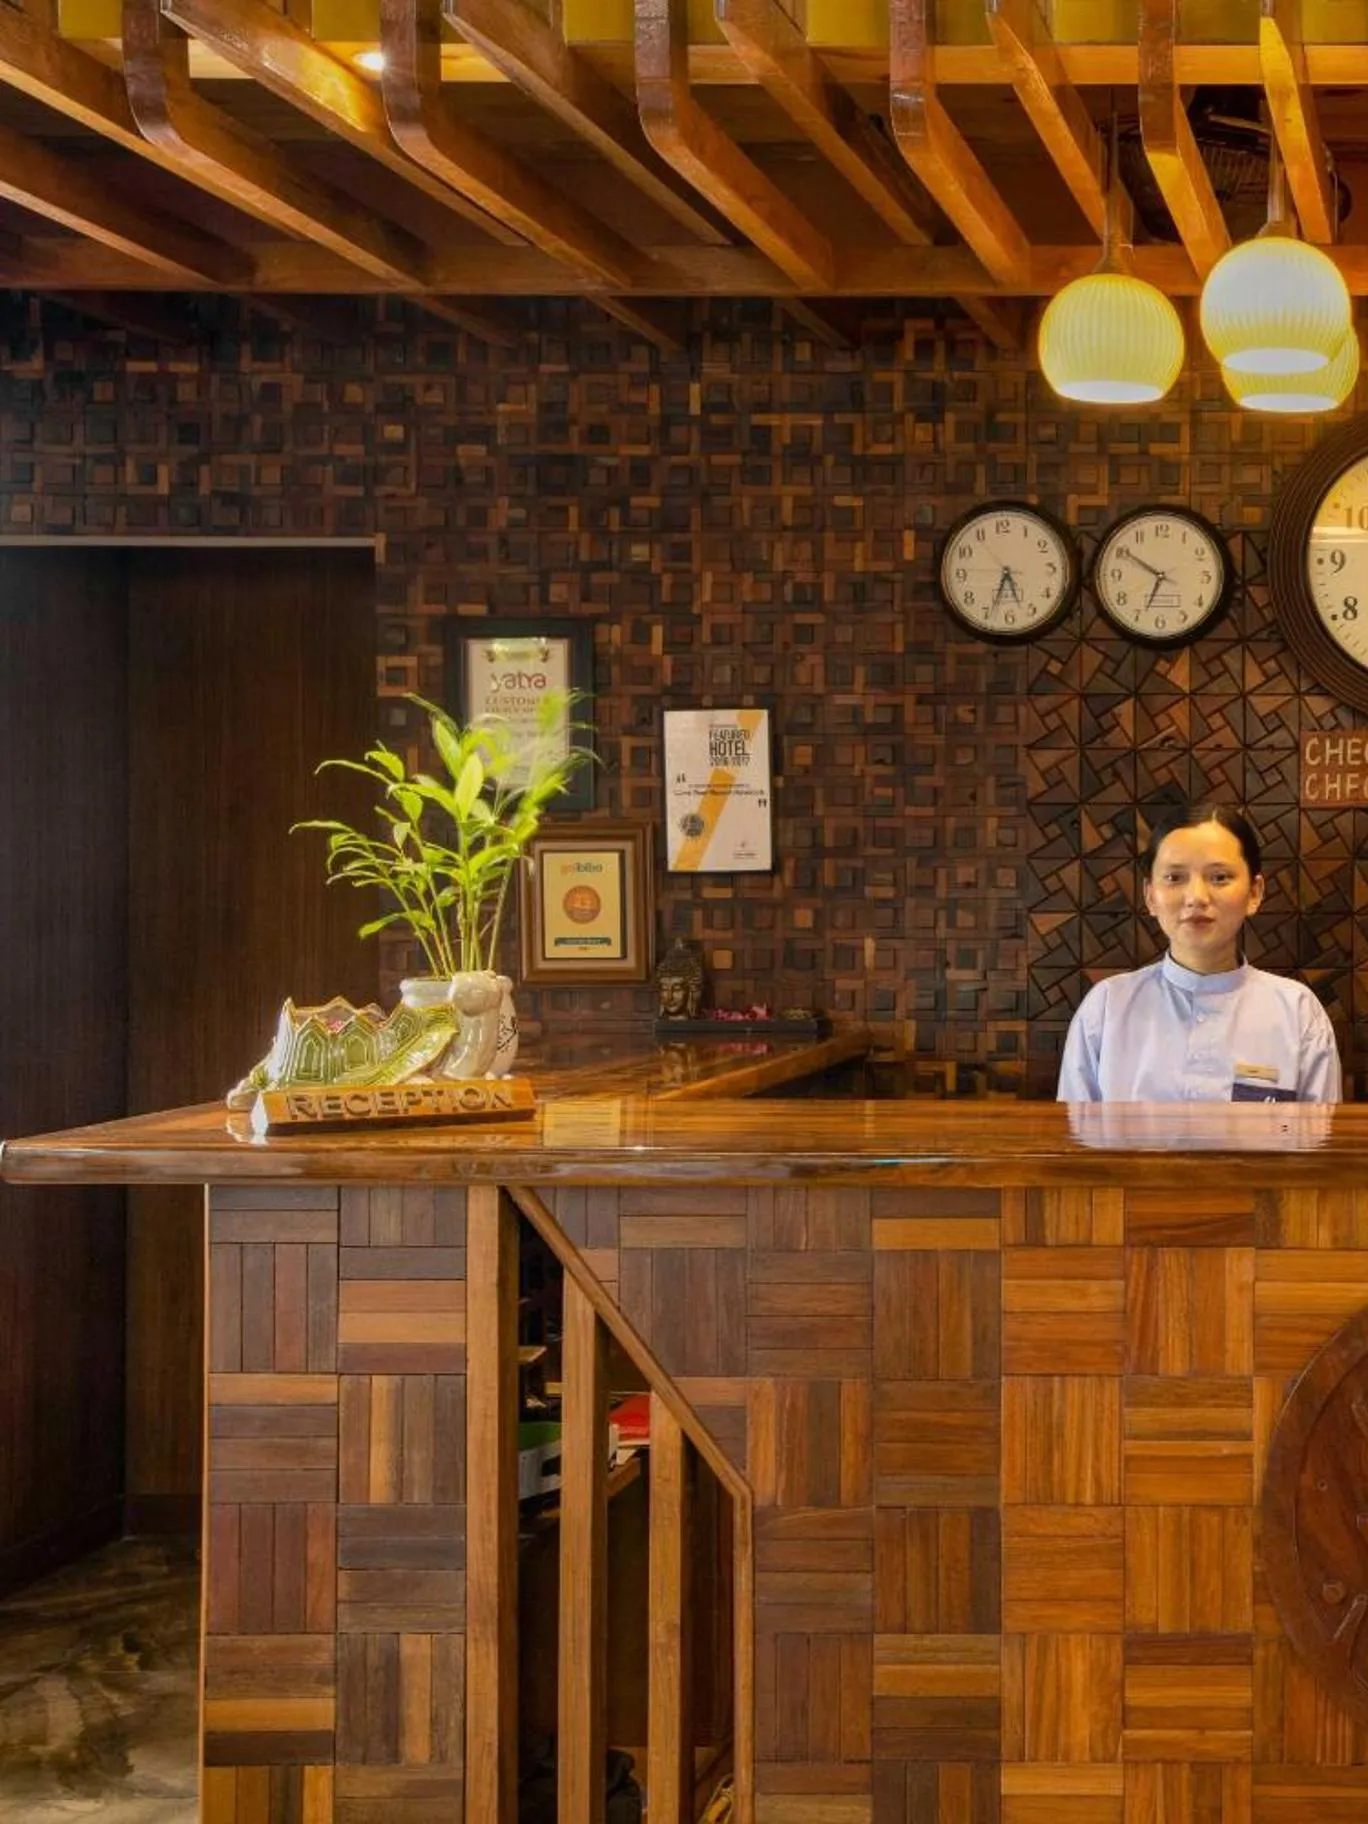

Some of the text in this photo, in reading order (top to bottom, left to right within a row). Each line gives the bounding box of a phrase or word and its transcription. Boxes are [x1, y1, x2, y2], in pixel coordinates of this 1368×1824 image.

[995, 520, 1010, 534] 12
[1023, 526, 1029, 538] 1
[1155, 524, 1169, 538] 12
[976, 528, 986, 541] 11
[1136, 531, 1145, 544] 11
[1181, 531, 1187, 544] 1
[959, 545, 973, 558] 10
[1037, 540, 1048, 554] 2
[1194, 547, 1205, 561] 2
[1330, 550, 1346, 573] 9
[956, 568, 967, 582] 9
[1111, 569, 1122, 583] 9
[964, 591, 974, 605] 8
[1040, 587, 1051, 599] 4
[1116, 591, 1126, 606] 8
[1193, 592, 1203, 608] 4
[981, 605, 989, 620] 7
[1133, 609, 1141, 622] 7
[1342, 596, 1359, 621] 8
[1004, 610, 1015, 625] 6
[1154, 616, 1166, 629] 6
[709, 740, 752, 756] HOTEL
